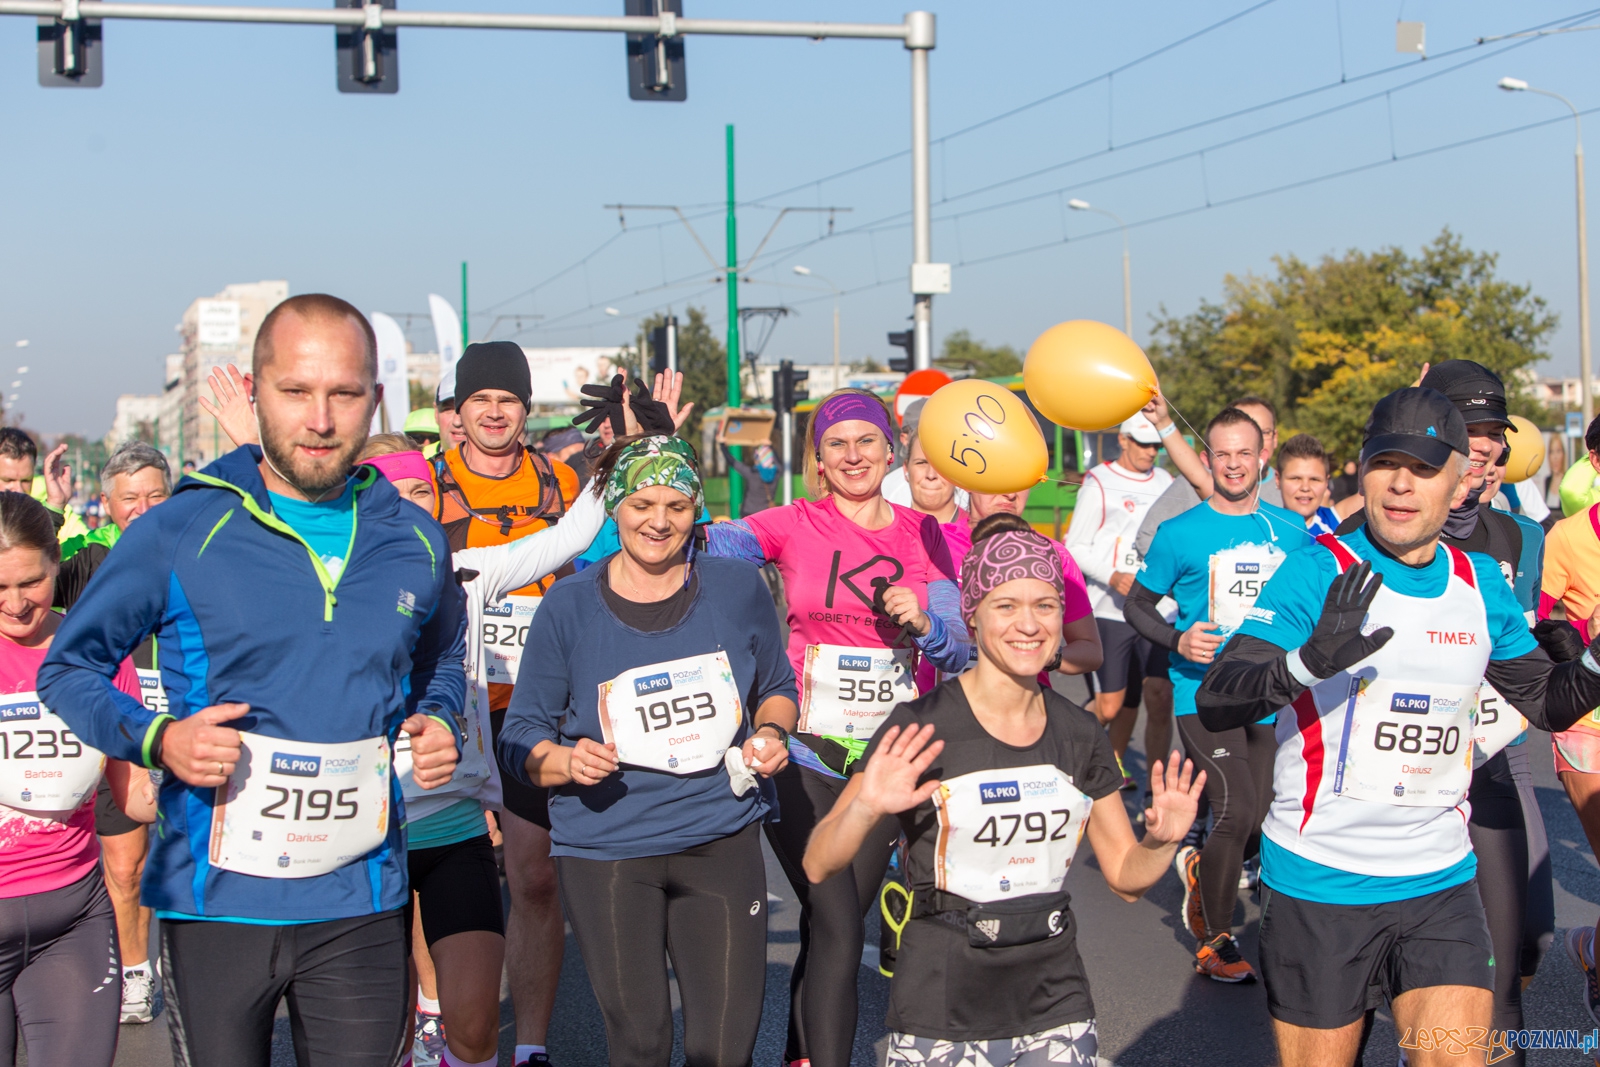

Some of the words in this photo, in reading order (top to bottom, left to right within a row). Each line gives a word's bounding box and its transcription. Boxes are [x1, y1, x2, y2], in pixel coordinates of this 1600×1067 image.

[950, 394, 1006, 475] 5:00
[1228, 580, 1269, 597] 45
[808, 611, 861, 626] KOBIETY
[1426, 631, 1477, 645] TIMEX
[852, 659, 869, 668] PKO
[650, 677, 669, 689] PKO
[675, 674, 704, 685] maraton
[838, 678, 894, 702] 358
[1408, 699, 1428, 709] PKO
[1432, 705, 1459, 713] maraton
[16, 706, 38, 716] PKO
[635, 692, 717, 733] 1953
[843, 708, 886, 718] Małgorzata
[668, 733, 701, 746] Dorota
[1374, 721, 1460, 755] 6830
[0, 729, 82, 760] 1235
[291, 760, 318, 772] PKO
[324, 765, 359, 774] maraton
[1401, 764, 1433, 775] Dariusz
[24, 770, 63, 779] Barbara
[998, 786, 1018, 798] PKO
[1024, 786, 1059, 797] maraton
[260, 785, 359, 821] 2195
[973, 809, 1071, 848] 4792
[286, 832, 329, 843] Dariusz
[1008, 856, 1036, 866] Anna
